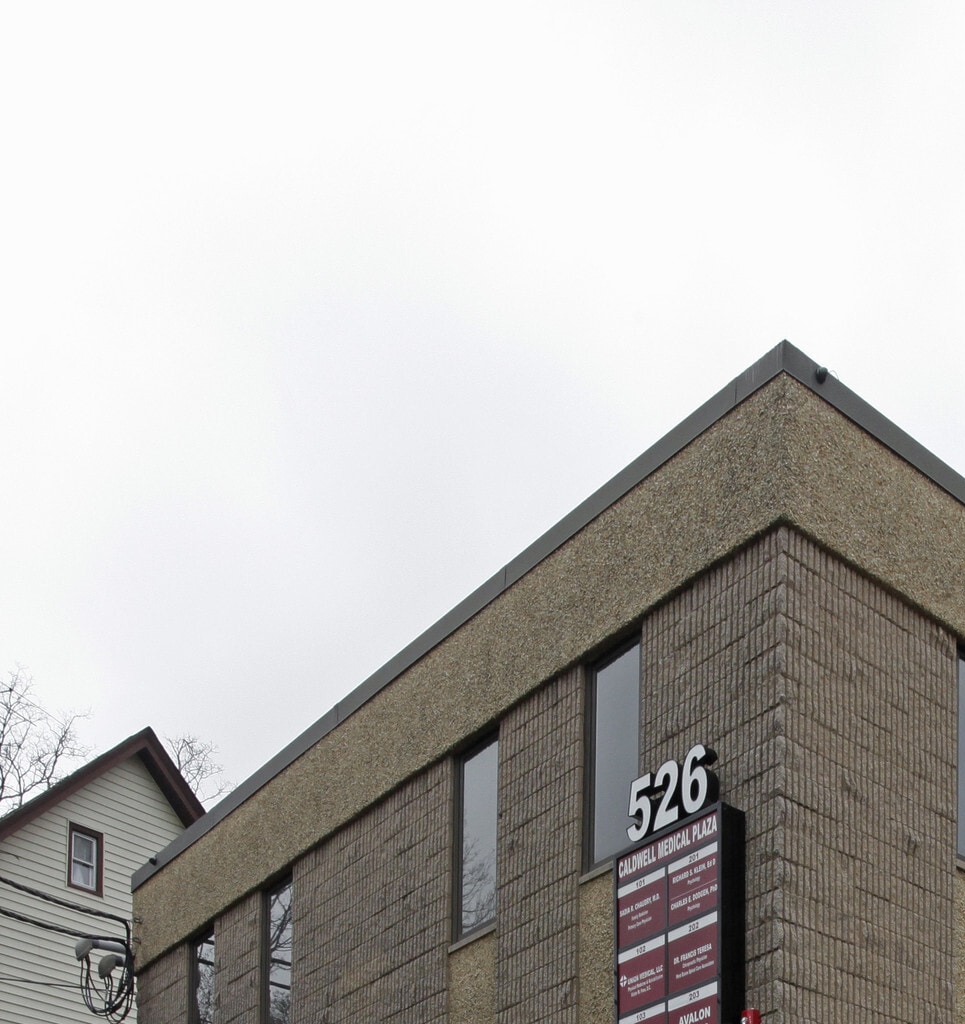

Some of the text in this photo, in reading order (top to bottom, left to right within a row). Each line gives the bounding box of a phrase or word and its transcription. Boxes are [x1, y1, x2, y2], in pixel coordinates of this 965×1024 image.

[626, 744, 708, 841] 526
[618, 816, 718, 878] CALDWELL MEDICAL PLAZA
[688, 853, 700, 862] 201
[636, 880, 646, 888] 101
[688, 923, 700, 932] 202
[636, 946, 646, 954] 102
[688, 991, 700, 1000] 203
